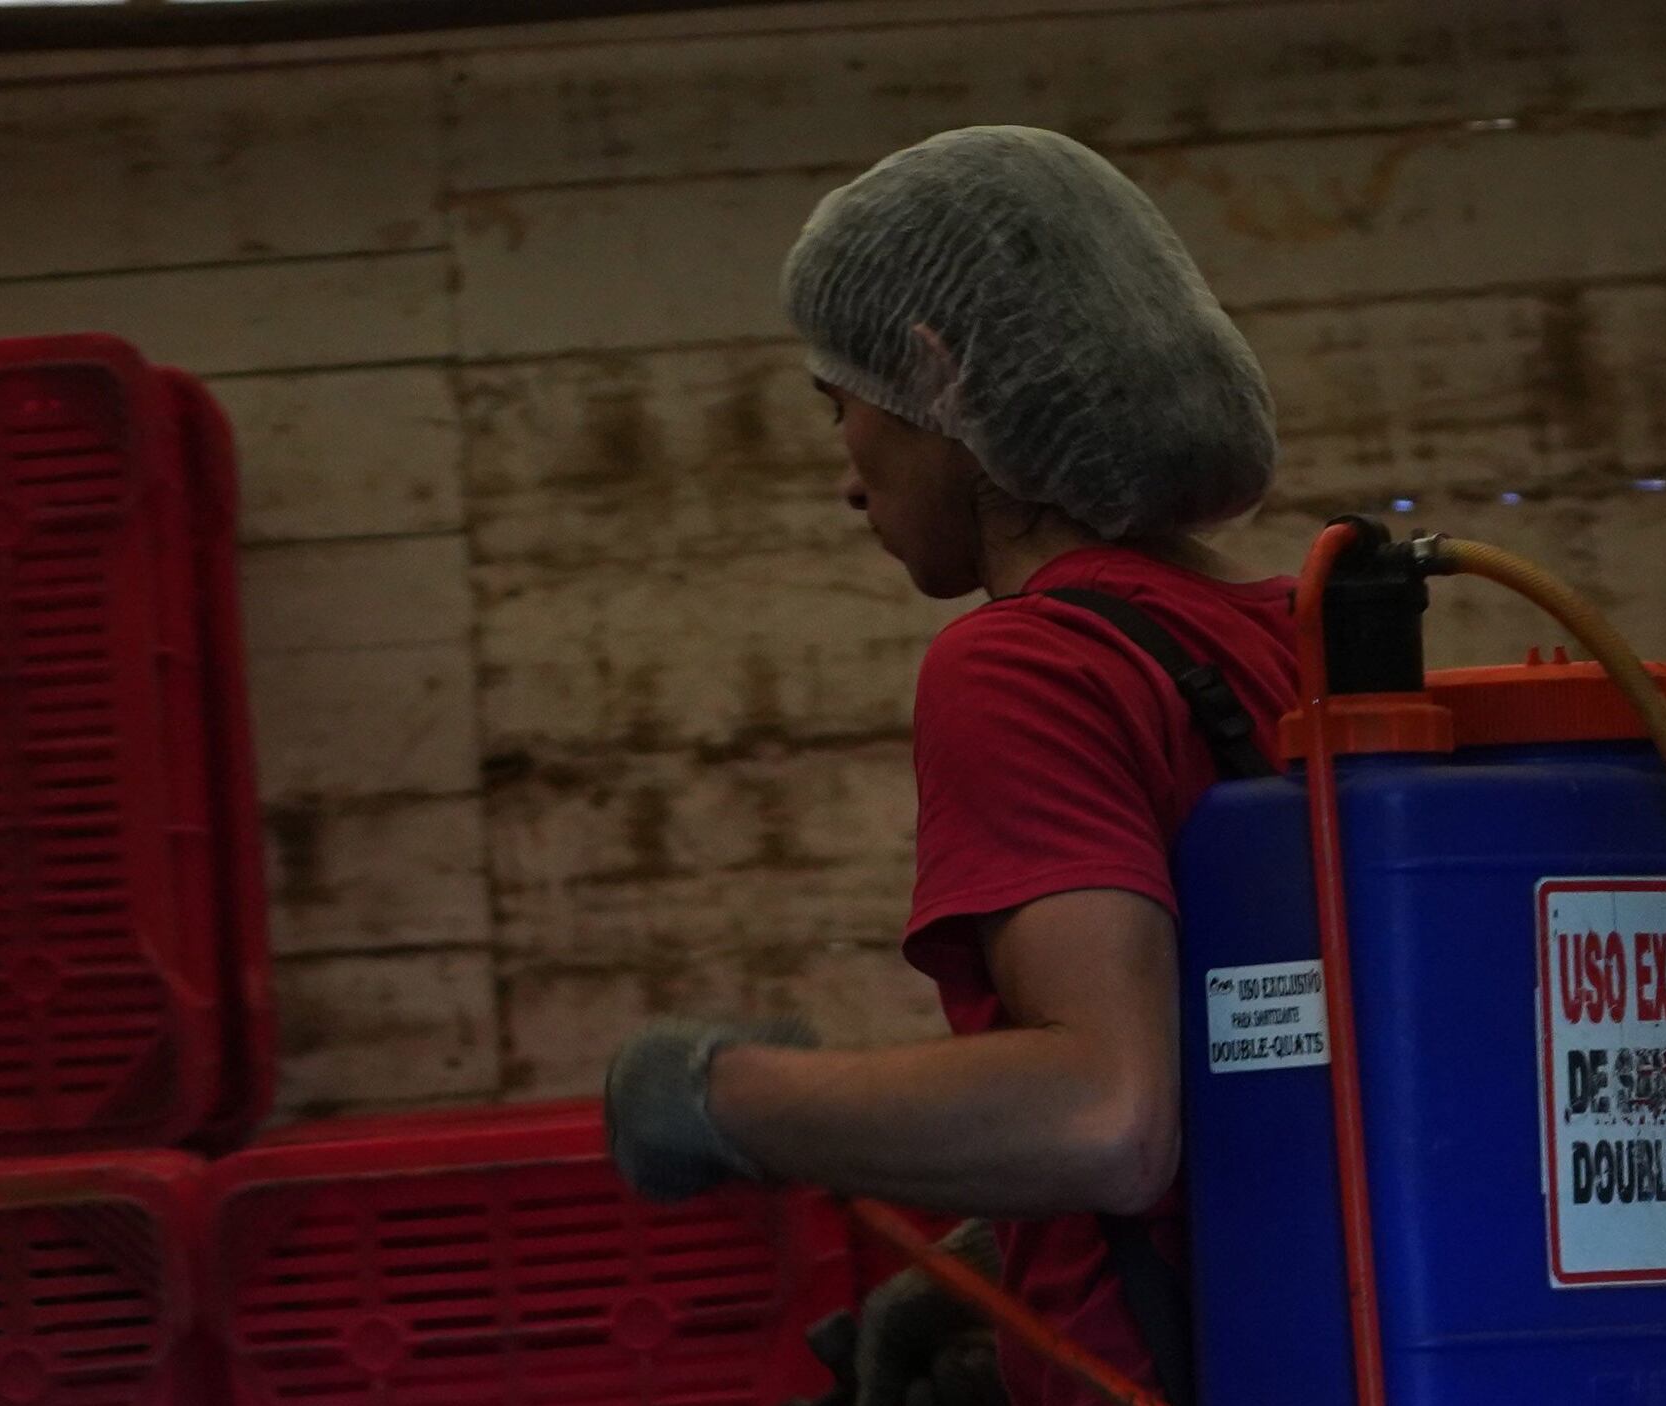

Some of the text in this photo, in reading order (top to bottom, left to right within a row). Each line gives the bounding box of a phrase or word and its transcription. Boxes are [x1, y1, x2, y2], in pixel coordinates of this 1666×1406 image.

[1238, 979, 1259, 1000] USO
[1262, 971, 1321, 998] EXCLUSIVO
[1559, 931, 1626, 1023] USO
[1212, 1032, 1324, 1062] DOUBLE-QUATS
[1568, 1050, 1608, 1113] DE
